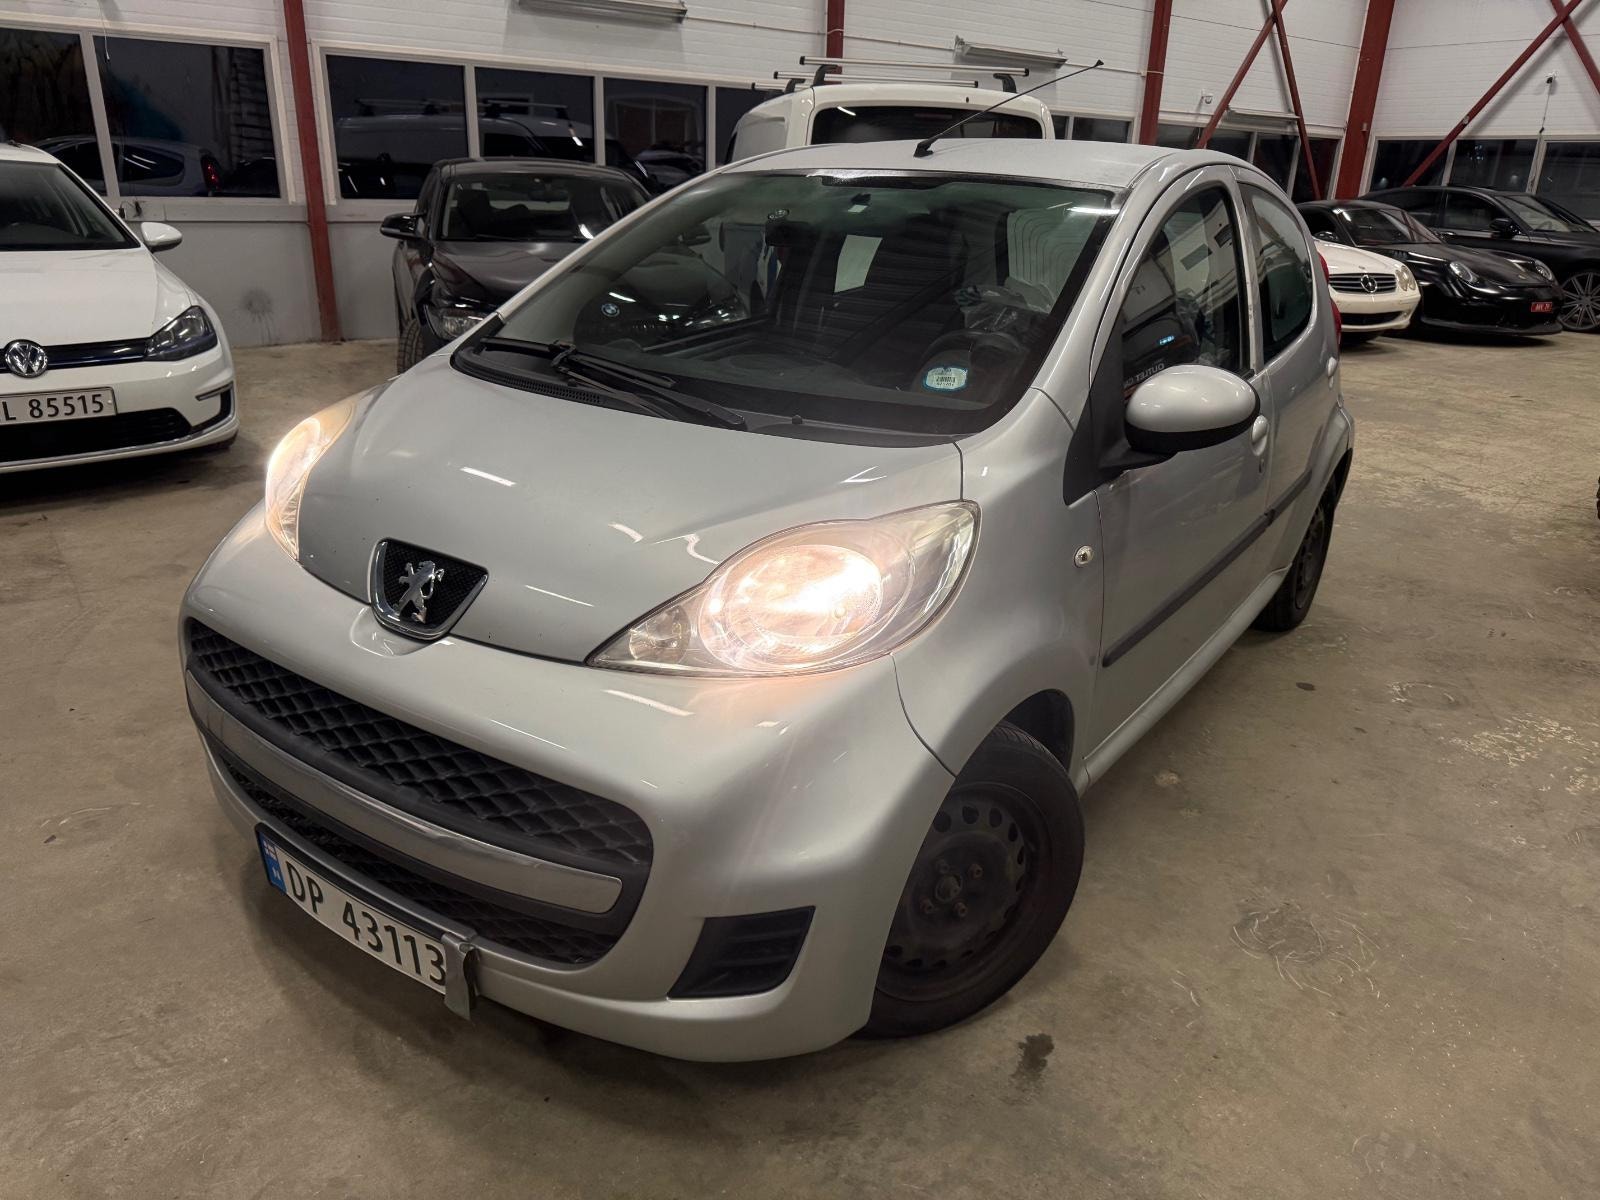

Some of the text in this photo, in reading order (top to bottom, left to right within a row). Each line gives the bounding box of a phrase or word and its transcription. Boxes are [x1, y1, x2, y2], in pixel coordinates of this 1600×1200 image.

[28, 394, 104, 419] 85515
[285, 860, 446, 987] DP 43113
